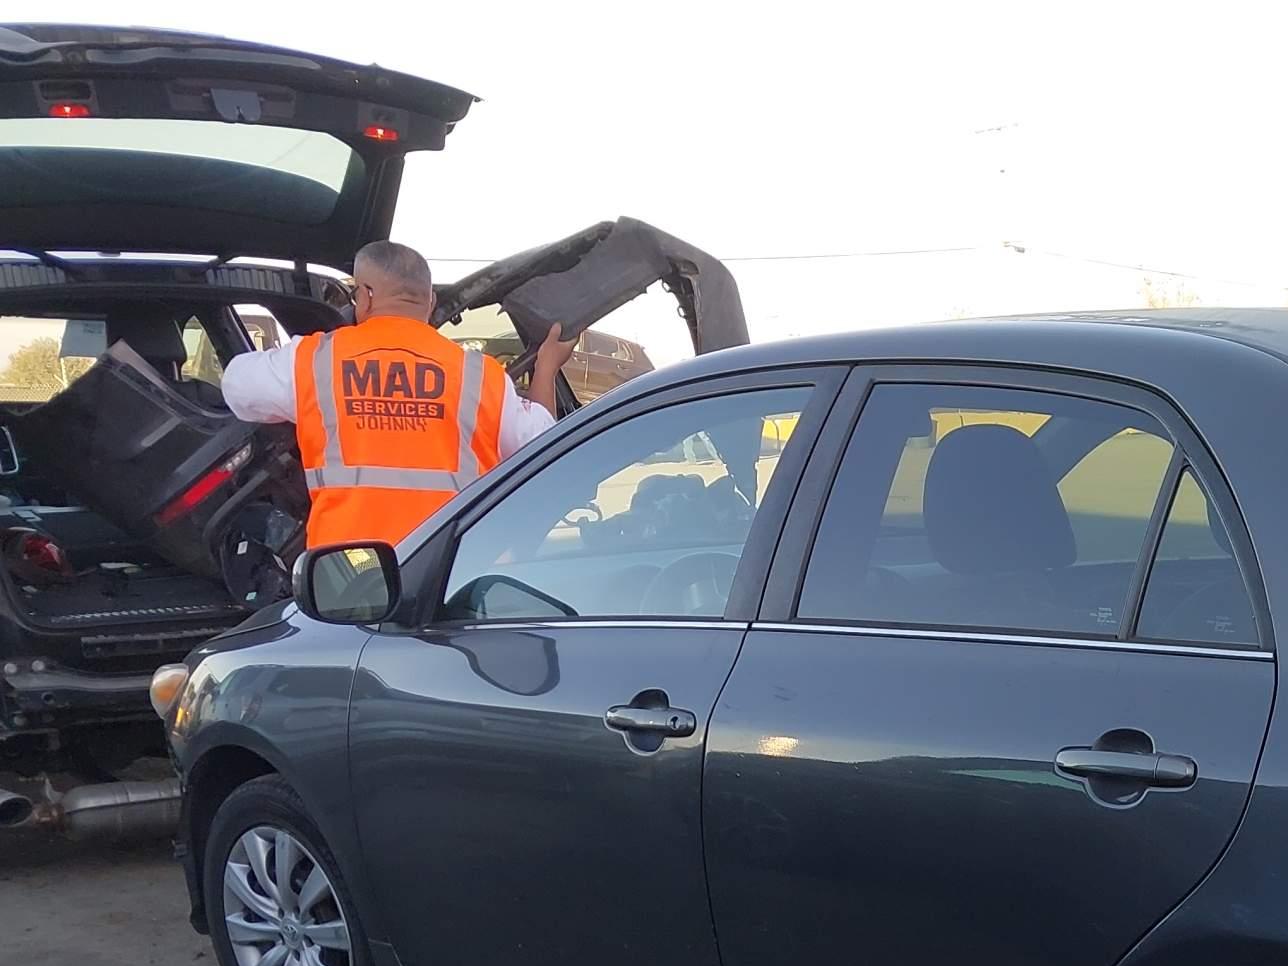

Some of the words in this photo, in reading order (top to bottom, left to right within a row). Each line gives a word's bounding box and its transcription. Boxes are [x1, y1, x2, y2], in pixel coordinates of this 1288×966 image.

[341, 360, 446, 400] MAD
[351, 402, 439, 417] SERVICES
[355, 416, 428, 432] JOHNNY
